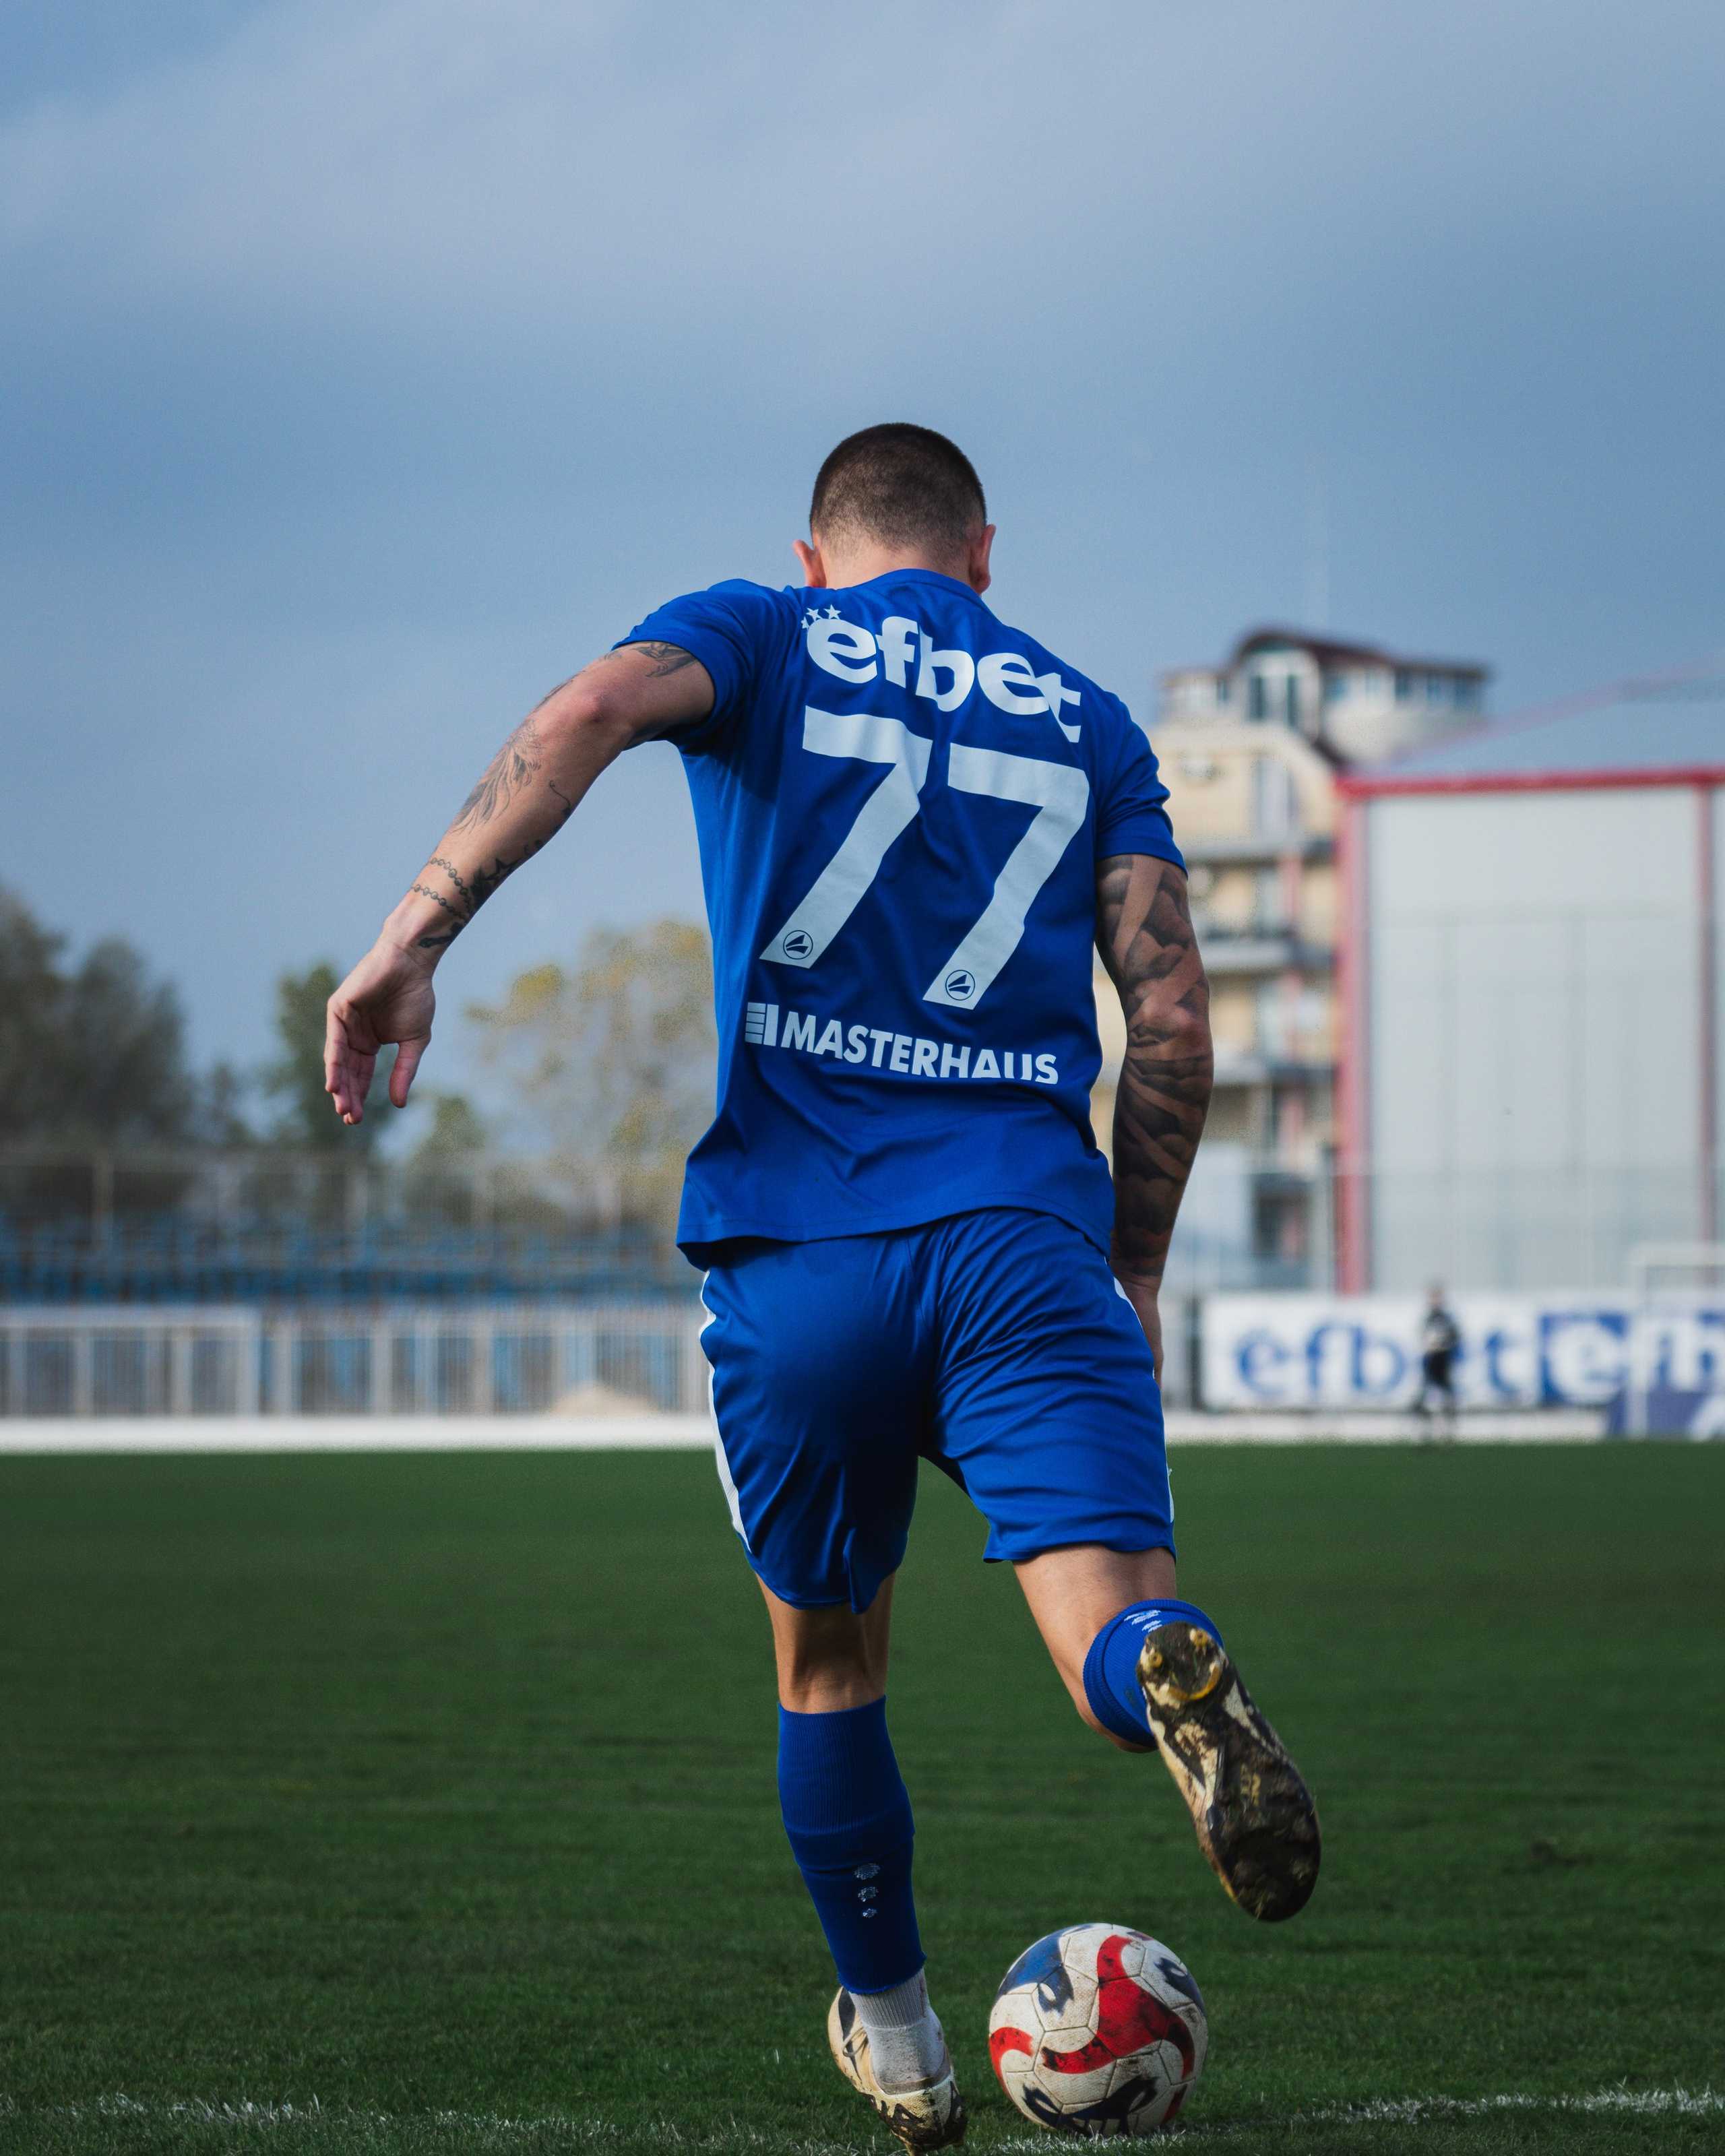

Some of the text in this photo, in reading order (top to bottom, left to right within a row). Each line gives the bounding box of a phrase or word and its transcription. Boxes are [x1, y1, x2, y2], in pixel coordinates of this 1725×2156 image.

[807, 616, 1081, 742] efbet
[759, 705, 1090, 1010] 77
[780, 1011, 1059, 1085] MASTERHAUS
[1236, 1321, 1522, 1396] efbt
